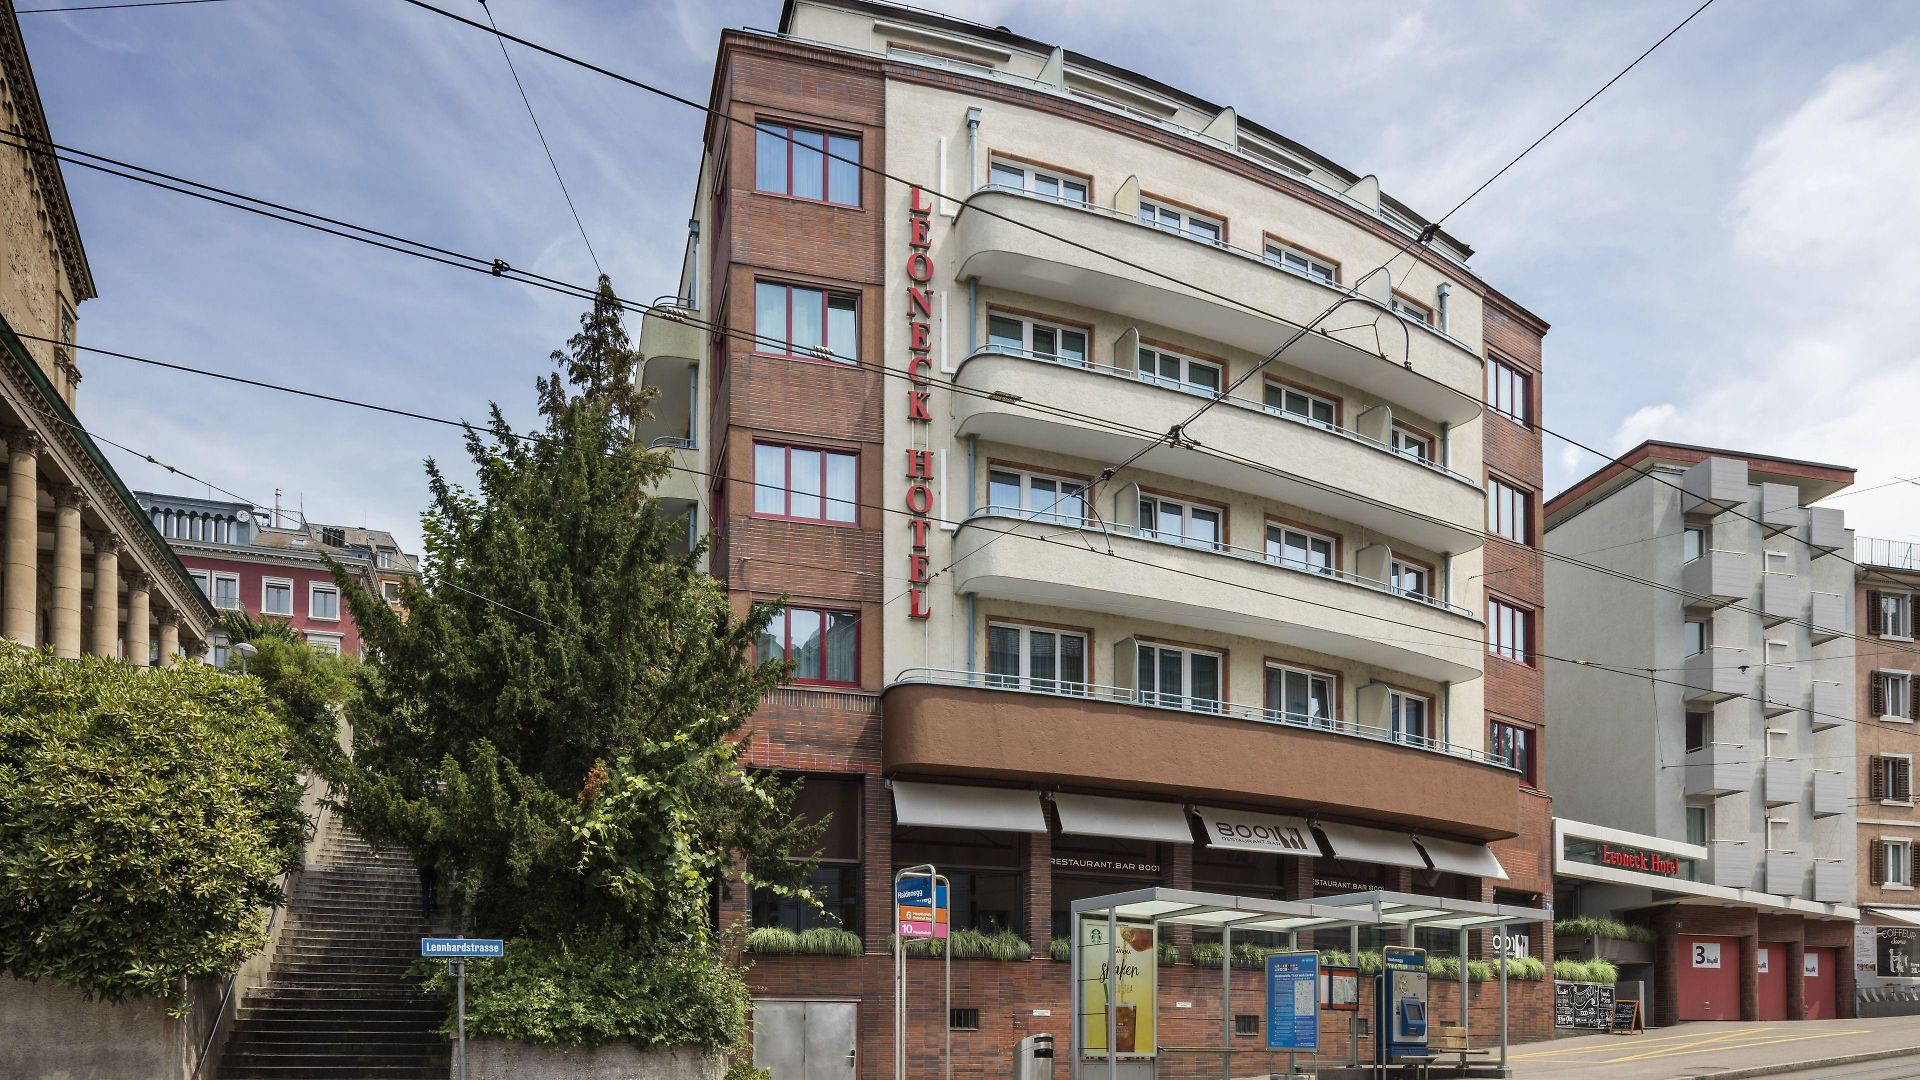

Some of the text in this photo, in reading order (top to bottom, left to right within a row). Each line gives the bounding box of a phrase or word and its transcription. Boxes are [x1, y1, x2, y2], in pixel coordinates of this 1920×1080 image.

[905, 184, 936, 620] LEONECK HOTEL
[1216, 822, 1279, 841] 8001
[1138, 863, 1161, 872] 8001
[1602, 844, 1680, 876] Leoneck Hotel
[906, 911, 912, 920] 6
[902, 923, 913, 934] 10
[426, 942, 499, 953] Leonhardstrasse
[1695, 945, 1706, 965] 3
